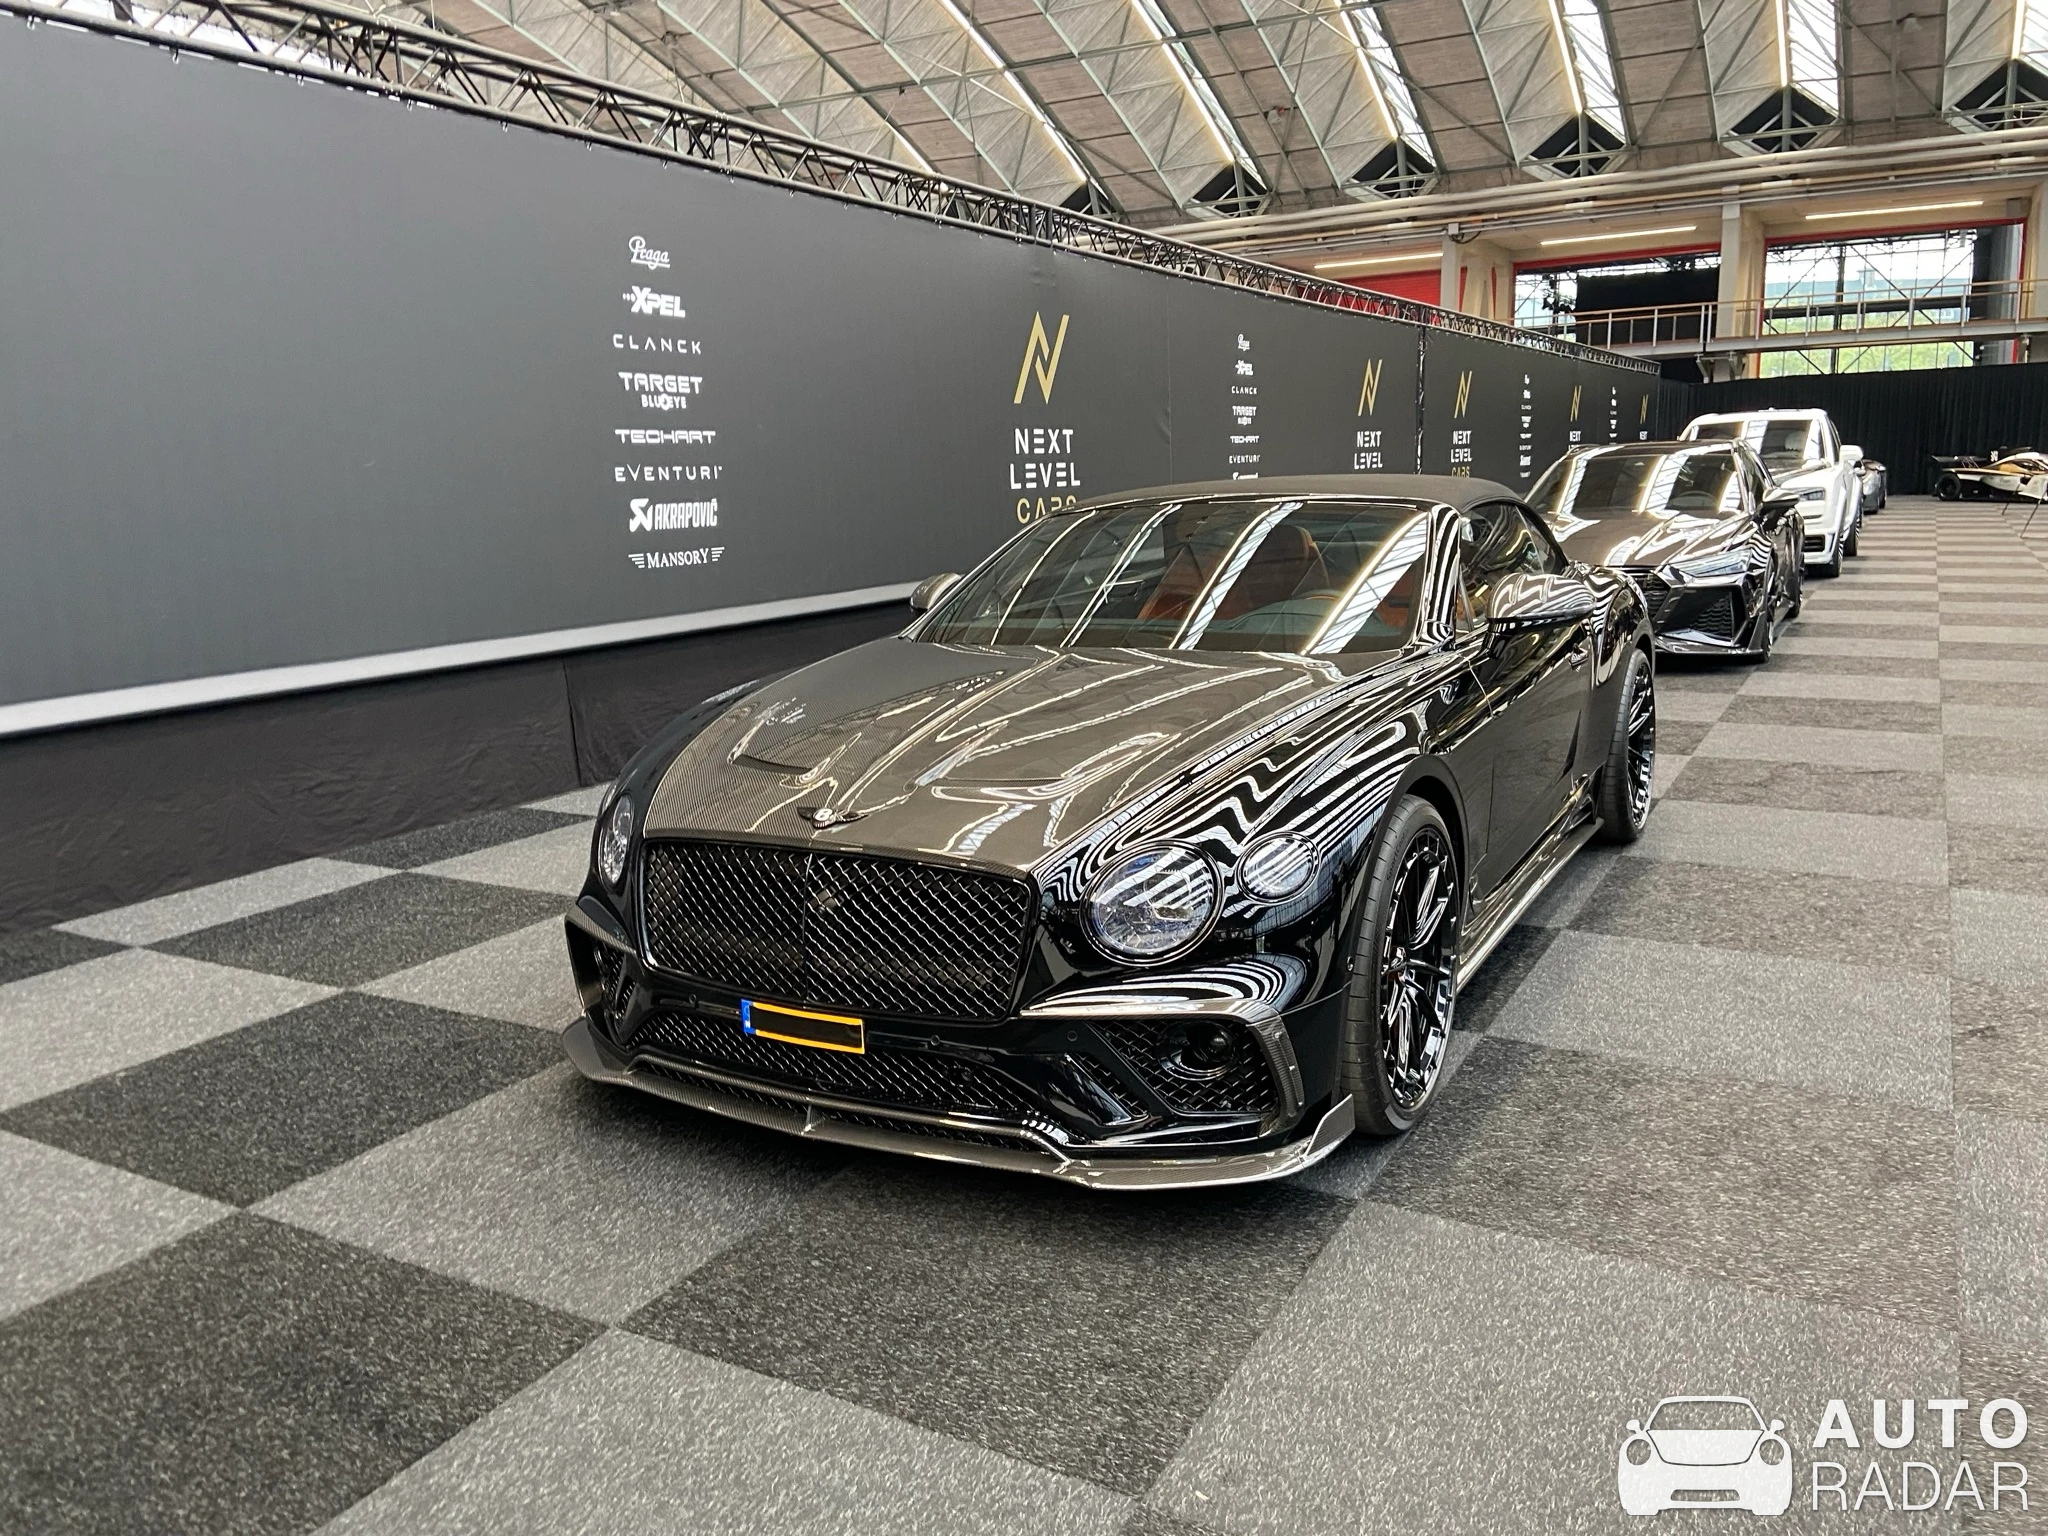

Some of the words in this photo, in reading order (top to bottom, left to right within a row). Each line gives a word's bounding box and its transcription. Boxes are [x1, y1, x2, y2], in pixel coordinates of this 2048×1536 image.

[629, 236, 670, 270] Praga
[631, 286, 686, 318] XPEL
[613, 334, 702, 355] CLANCK
[618, 371, 703, 394] TARGET
[614, 429, 716, 444] TECHART
[1014, 428, 1074, 454] NEXT
[1356, 430, 1382, 448] NEXT
[1452, 430, 1472, 445] NEXT
[1353, 452, 1383, 470] LEVEL
[1450, 448, 1473, 463] LEVEL
[1010, 462, 1081, 489] LEVEL
[646, 548, 709, 569] MANSORY
